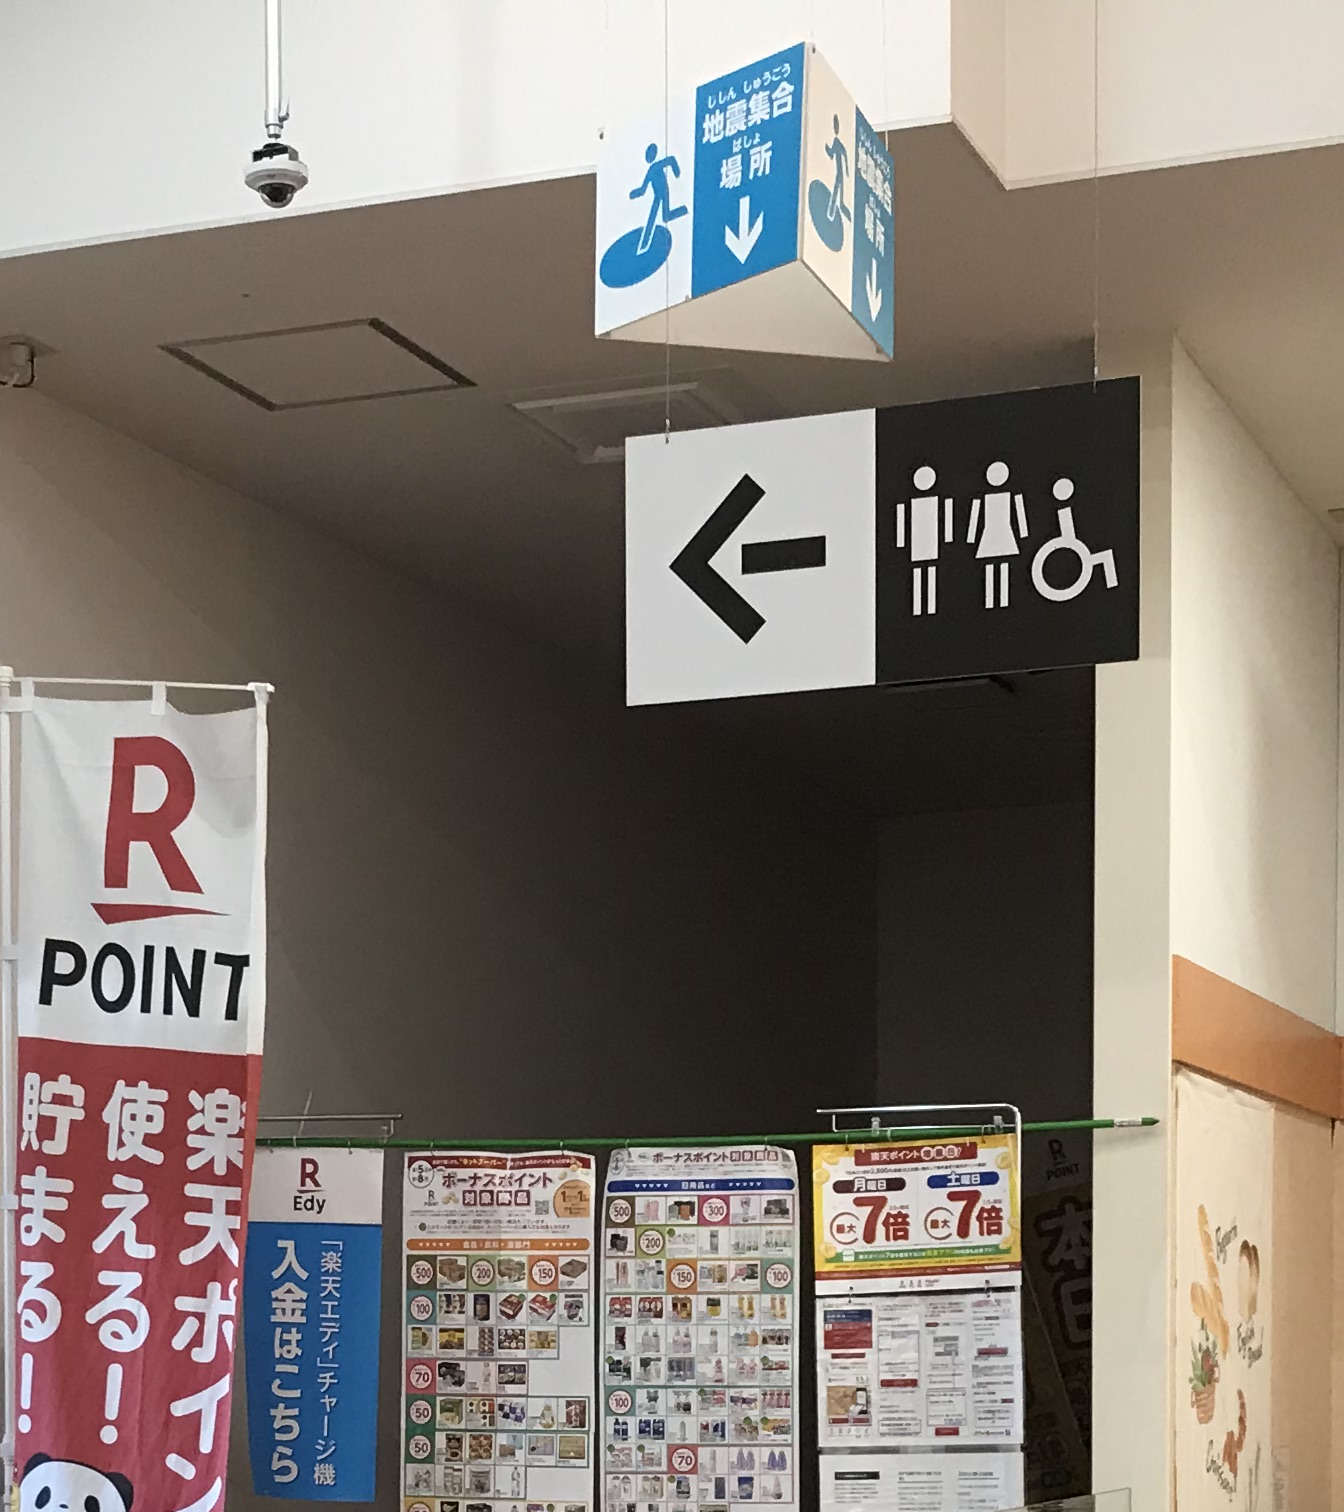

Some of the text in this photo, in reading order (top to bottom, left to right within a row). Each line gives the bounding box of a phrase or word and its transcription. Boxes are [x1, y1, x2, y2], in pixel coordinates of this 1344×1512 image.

[702, 80, 795, 144] 地震集合
[719, 141, 773, 190] 場所
[104, 736, 205, 894] R
[38, 938, 250, 1021] POINT
[299, 1157, 322, 1188] R
[442, 1172, 554, 1190] ボーナスポイント
[854, 1176, 887, 1192] 月曜日
[947, 1171, 982, 1186] 土曜日
[293, 1195, 326, 1214] Edy
[269, 1239, 310, 1485] 入金はこちら
[312, 1240, 344, 1487] 「楽天エディ」チャージ機
